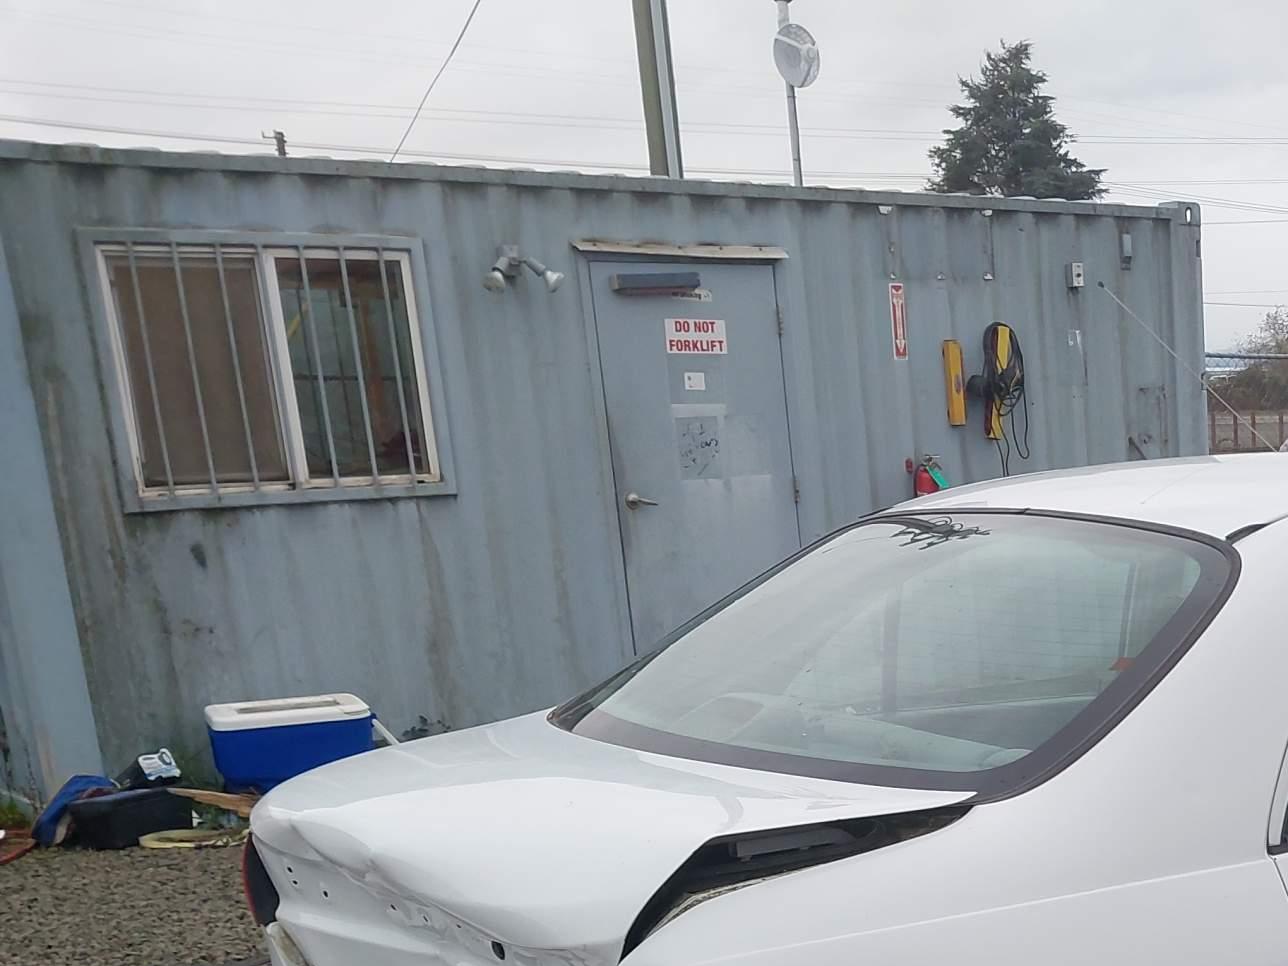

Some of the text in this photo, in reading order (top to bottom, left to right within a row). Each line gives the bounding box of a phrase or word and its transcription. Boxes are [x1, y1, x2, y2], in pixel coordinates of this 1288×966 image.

[674, 320, 716, 333] DO NOT
[668, 339, 725, 352] FORKLIFT
